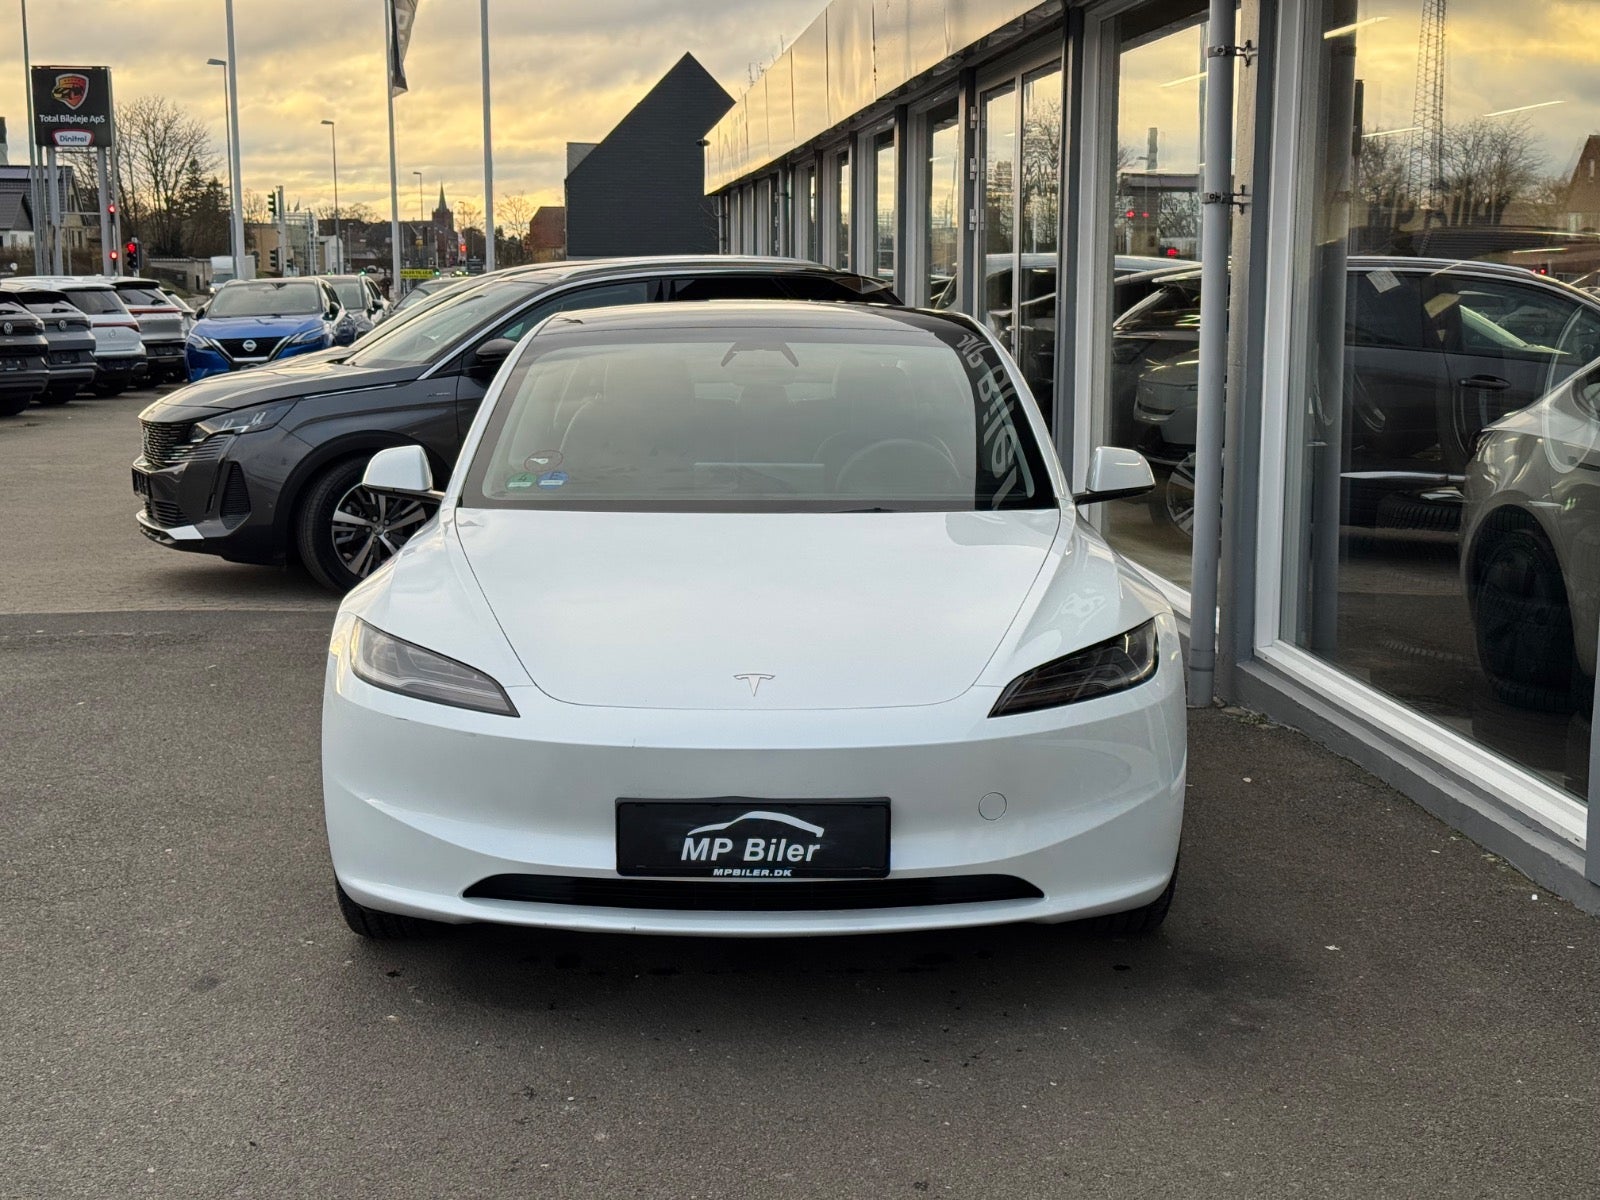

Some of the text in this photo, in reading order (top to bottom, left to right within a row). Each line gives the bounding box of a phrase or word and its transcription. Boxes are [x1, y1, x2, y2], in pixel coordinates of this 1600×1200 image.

[39, 114, 105, 124] Total Bilpleje ApS
[680, 837, 821, 862] MP Biler
[712, 868, 792, 877] MPBILER.DK
